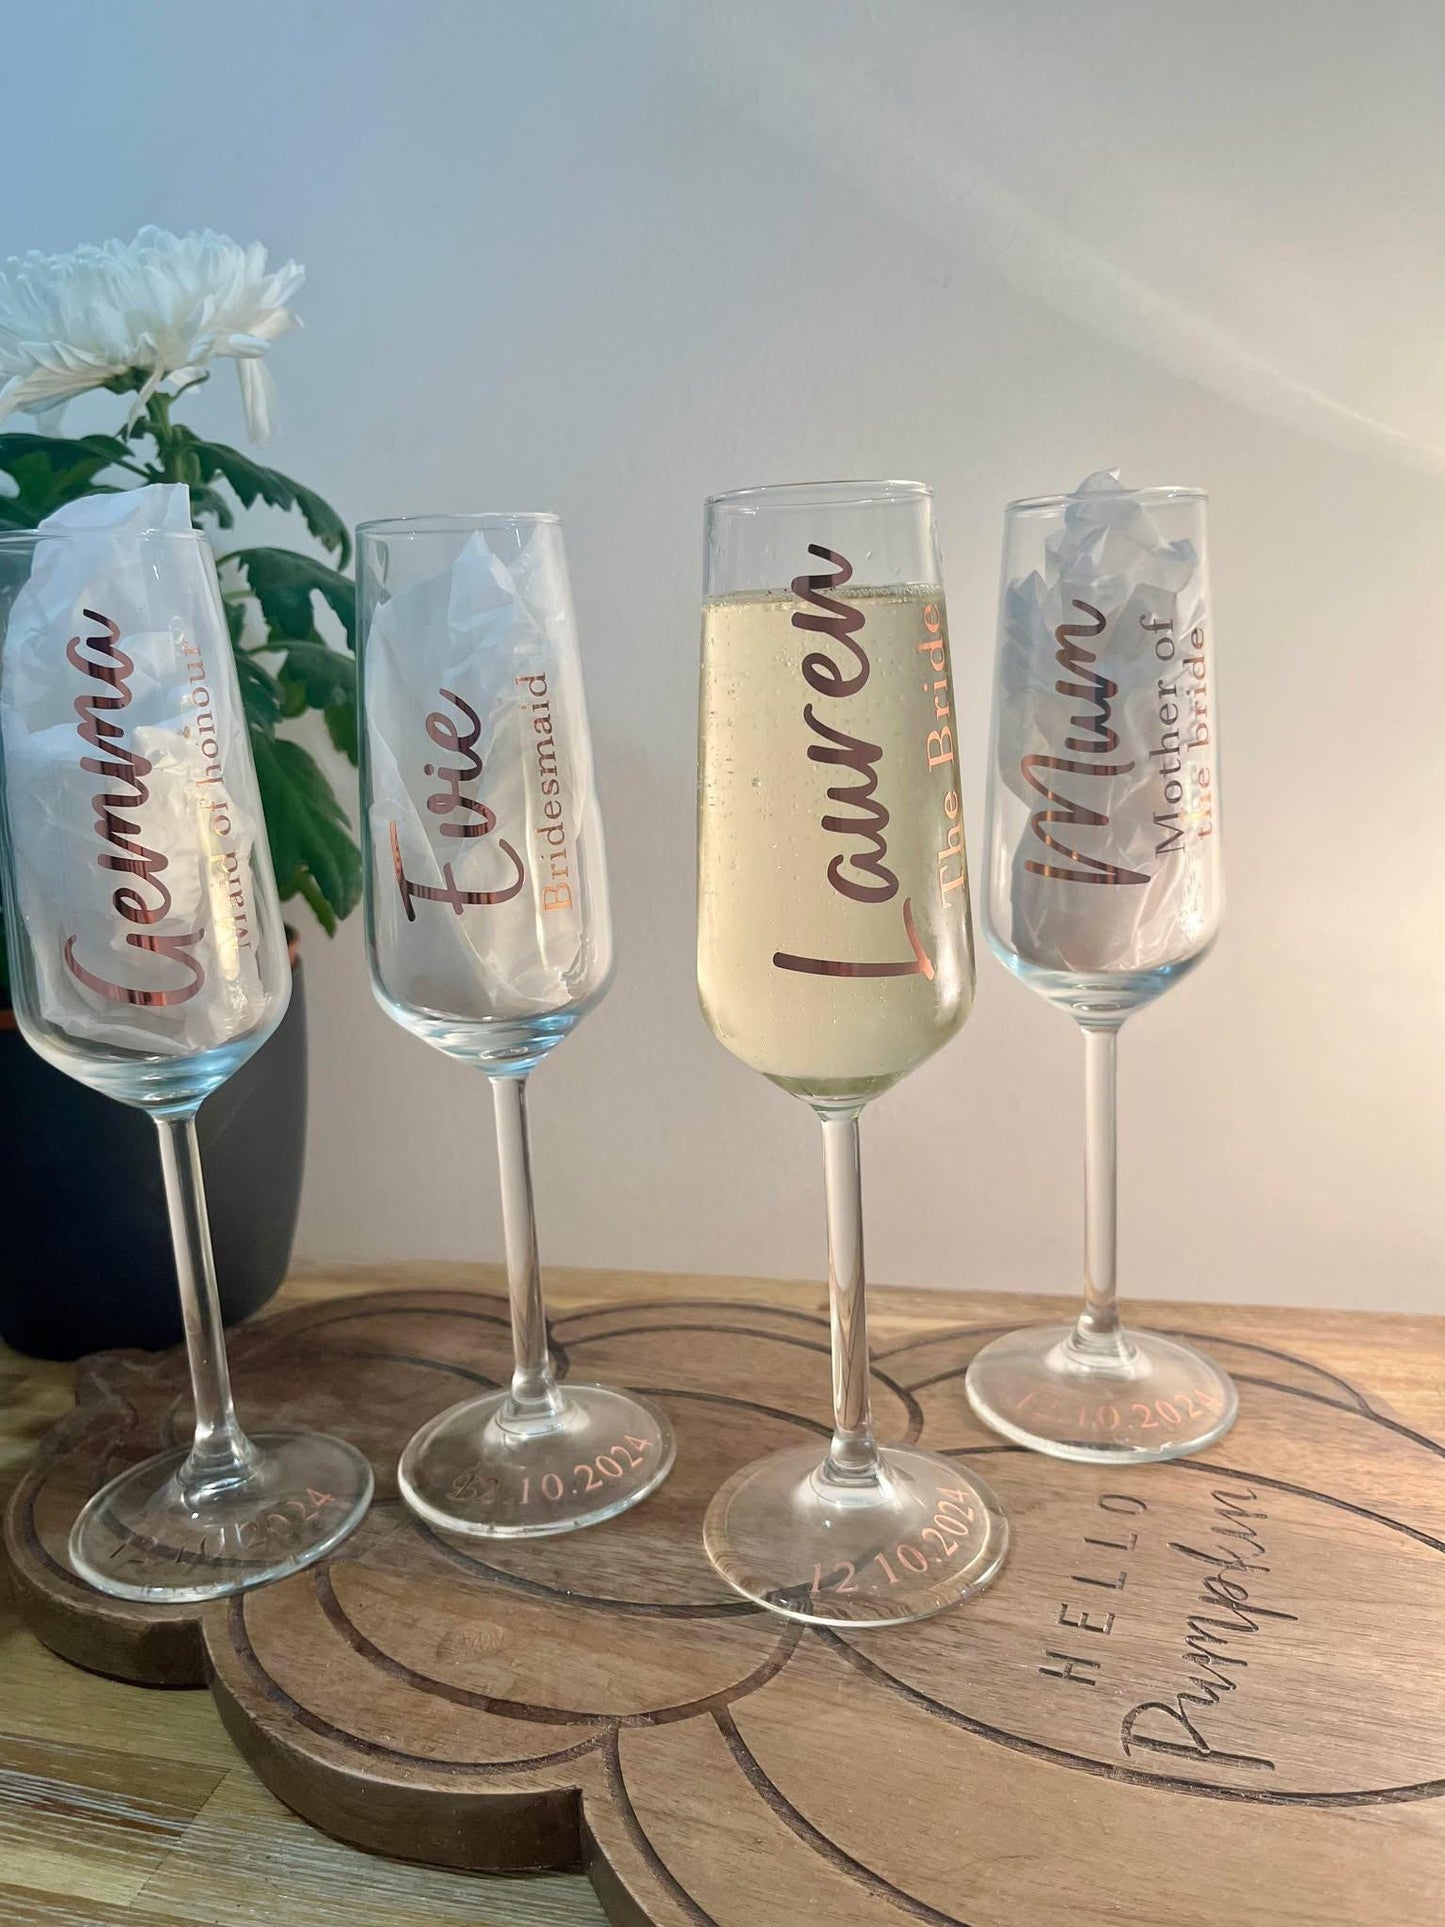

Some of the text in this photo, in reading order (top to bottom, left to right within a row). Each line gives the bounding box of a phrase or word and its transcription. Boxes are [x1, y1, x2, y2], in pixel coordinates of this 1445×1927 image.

[64, 609, 205, 1006] Gemma
[180, 638, 252, 951] Maid of honour
[389, 688, 524, 922] Evie
[515, 672, 572, 912] Bridesmaid
[773, 544, 936, 980] Lauren
[916, 604, 965, 908] The Bride
[1021, 599, 1151, 885] Mum
[1139, 614, 1186, 858] Mother of
[1183, 628, 1213, 840] the bride
[810, 1486, 976, 1593] 12.10.2024
[1038, 1494, 1148, 1687] HELLO
[1120, 1488, 1298, 1771] Pumpkin
